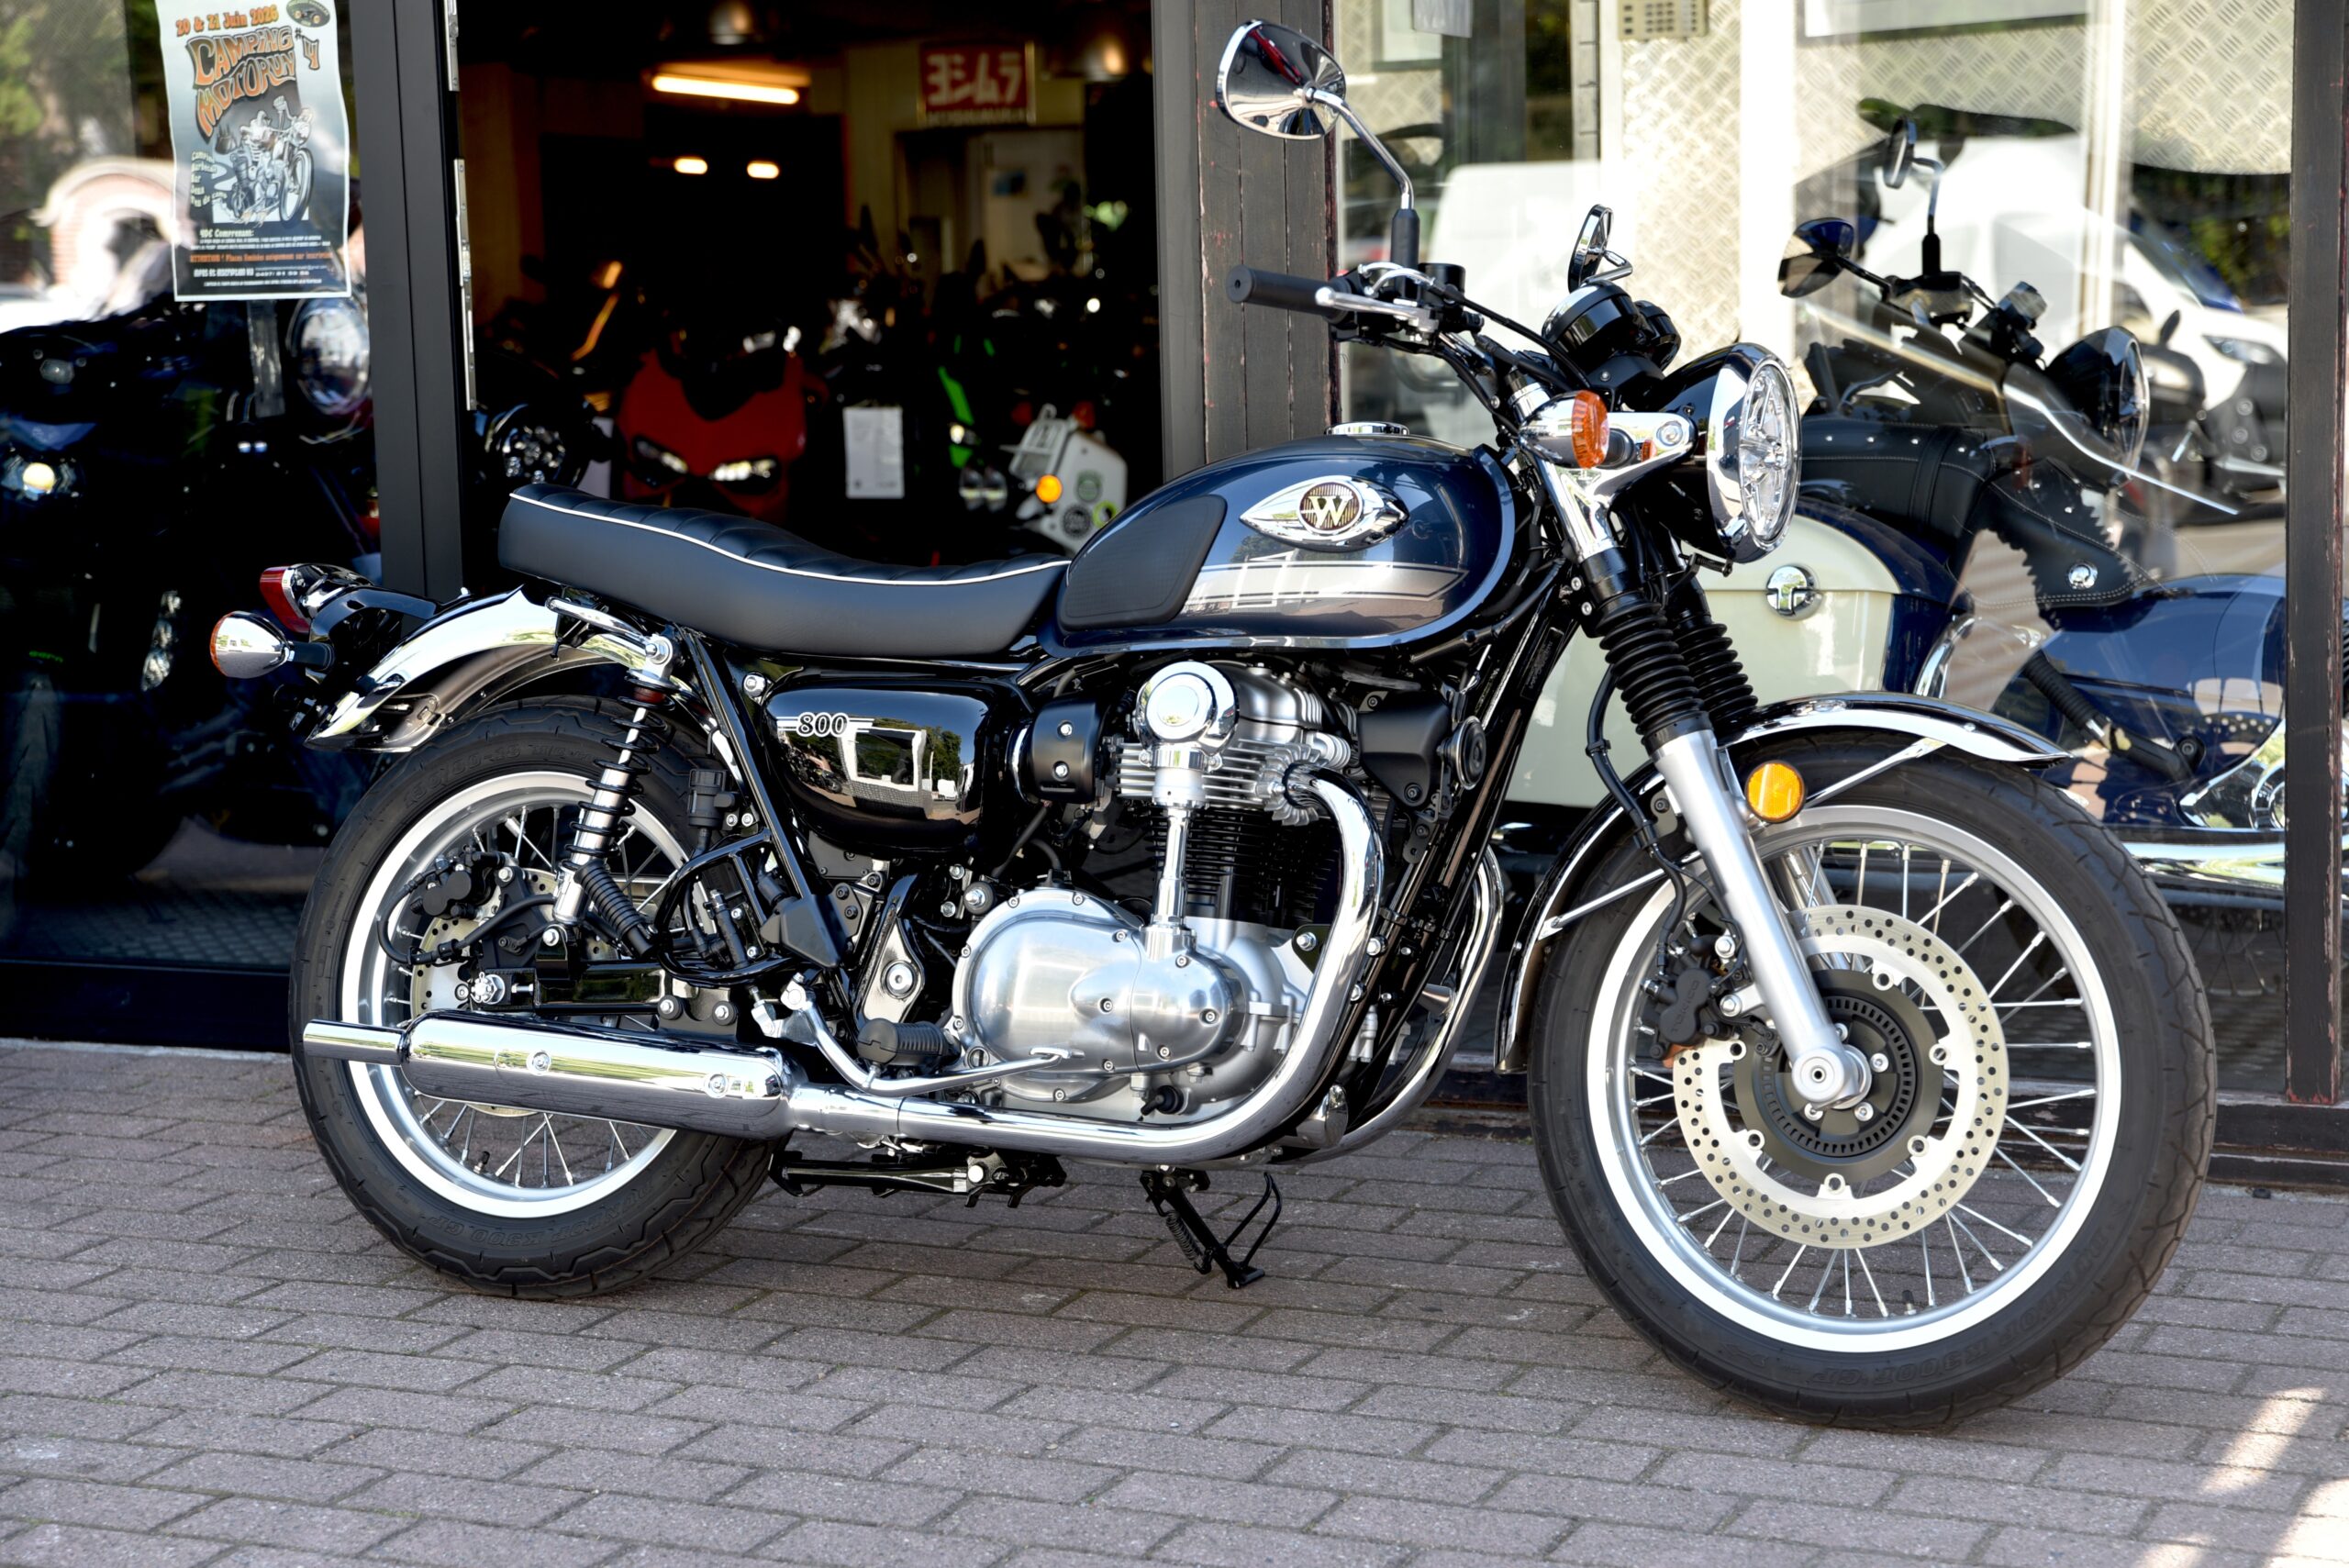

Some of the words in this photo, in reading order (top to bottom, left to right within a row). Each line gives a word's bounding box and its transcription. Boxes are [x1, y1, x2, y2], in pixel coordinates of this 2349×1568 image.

[176, 18, 190, 37] 20
[194, 17, 204, 31] &
[207, 14, 220, 29] 21
[223, 11, 248, 28] Juin
[250, 6, 279, 24] 2026
[187, 26, 295, 87] CAMPING
[926, 51, 1023, 106] ヨシムラ
[195, 51, 296, 140] MOTORUN
[1308, 495, 1353, 528] W
[796, 711, 849, 738] 800
